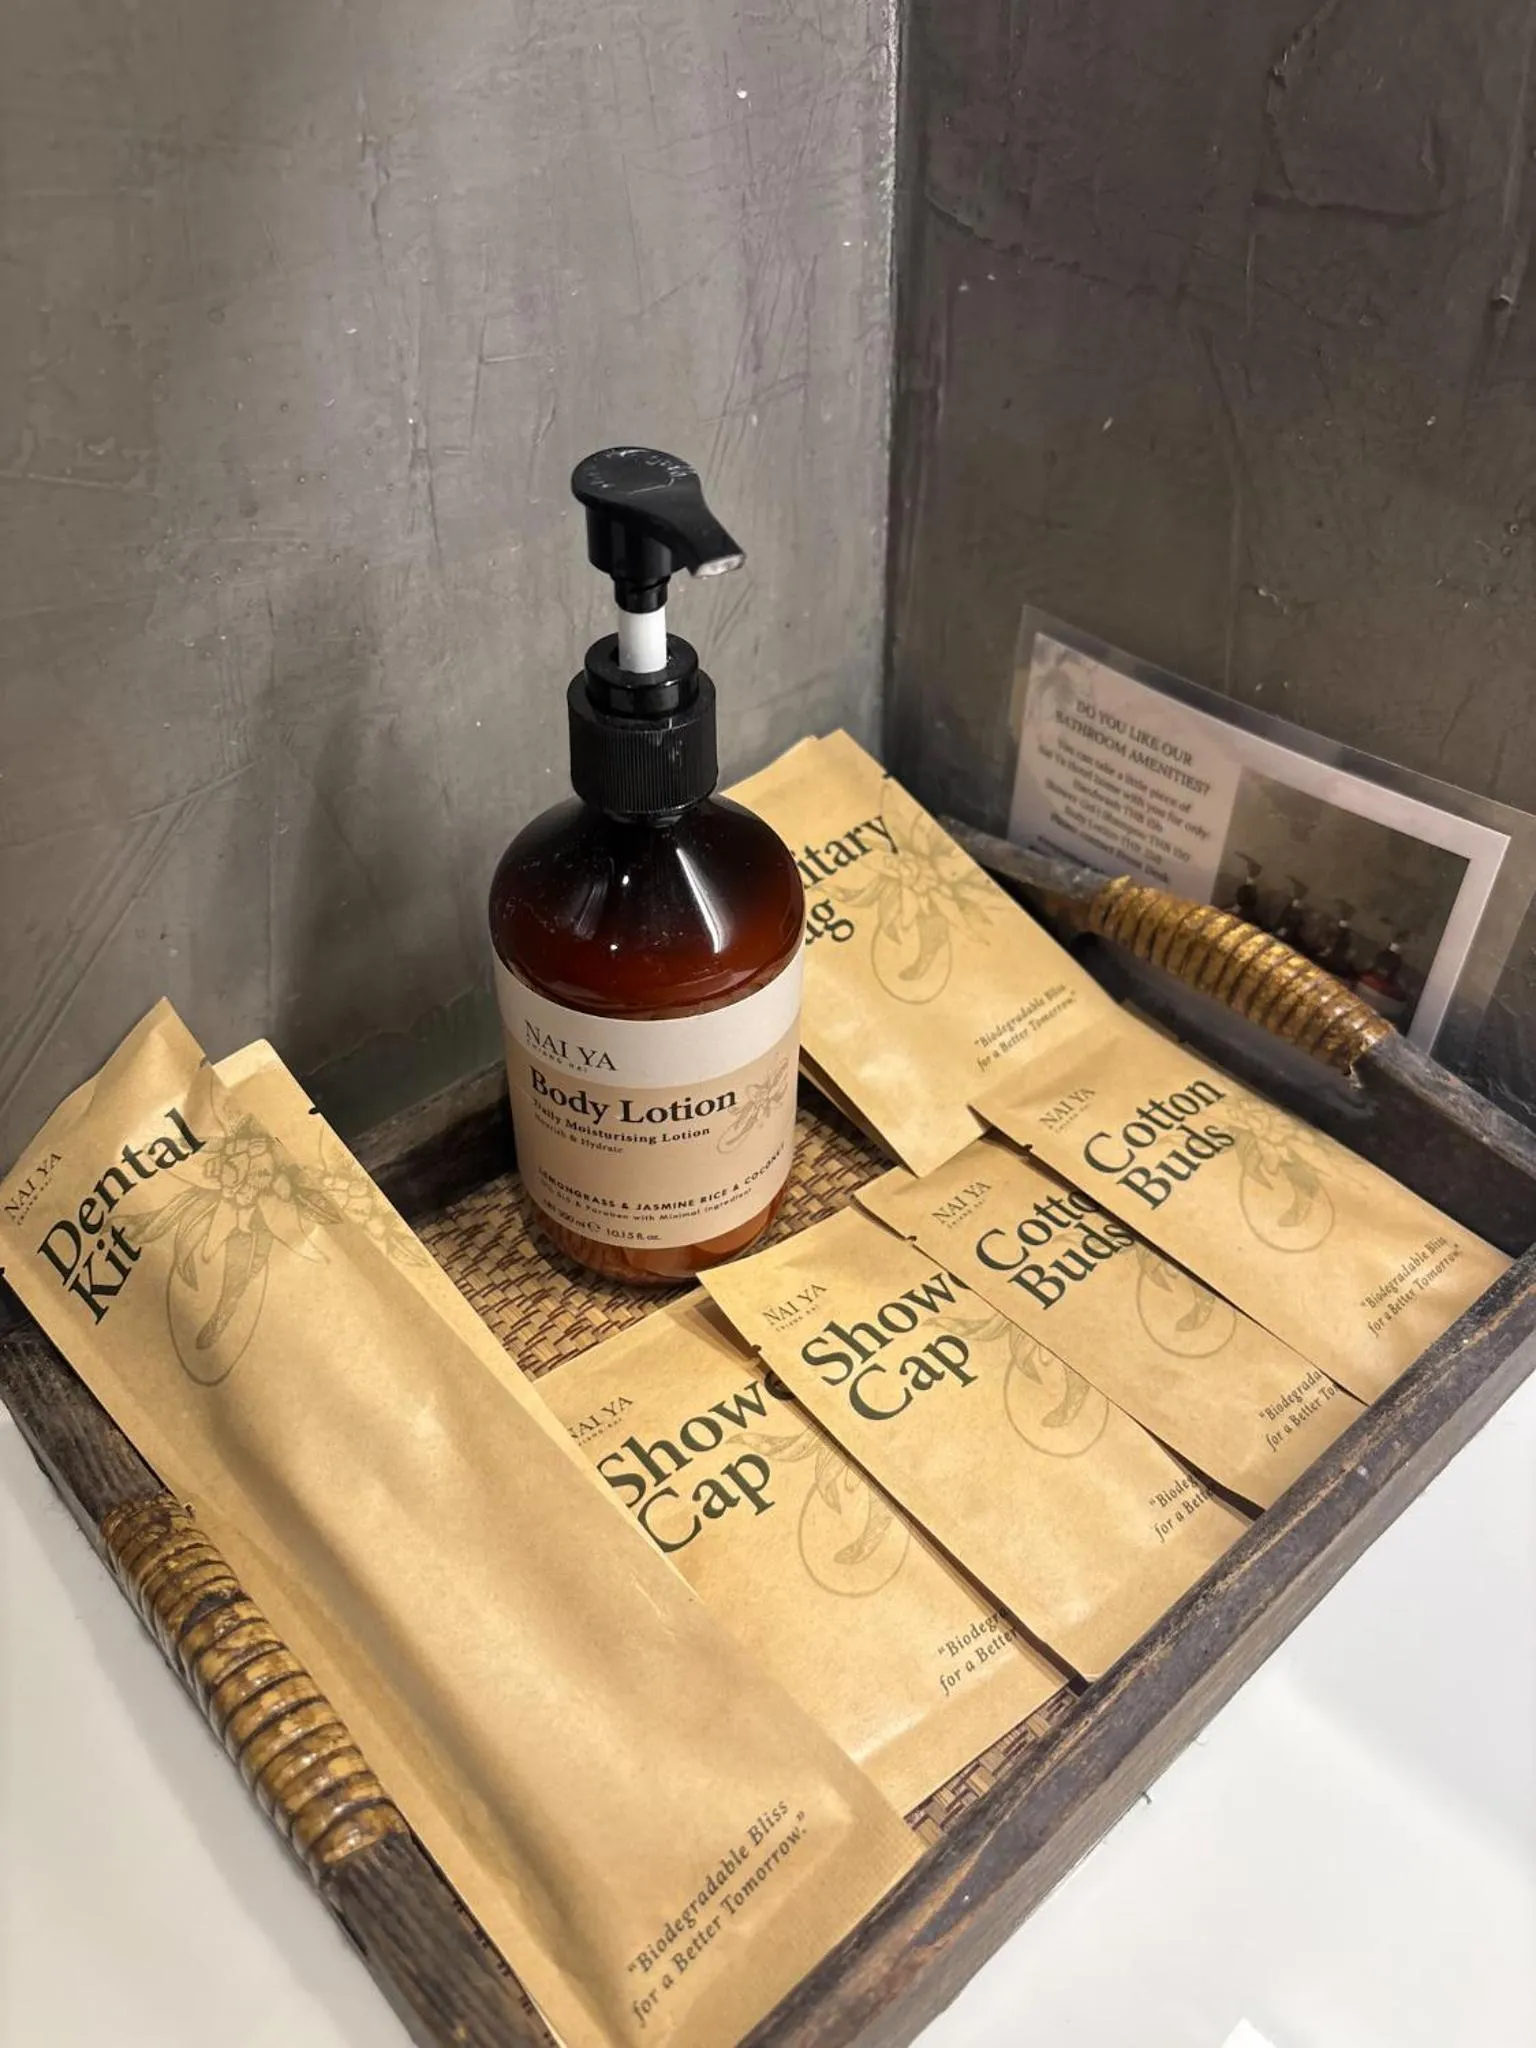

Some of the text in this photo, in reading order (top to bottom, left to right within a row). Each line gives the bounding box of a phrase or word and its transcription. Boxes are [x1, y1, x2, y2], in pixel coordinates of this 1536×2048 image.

[1055, 710, 1212, 796] BATHROOM AMENITIES?
[1099, 710, 1129, 736] YOU
[1129, 725, 1159, 752] LIKE
[1162, 741, 1194, 768] OUR
[525, 1019, 618, 1071] NAI YA
[977, 1055, 992, 1073] for
[992, 1049, 1000, 1059] a
[529, 1064, 737, 1126] Body Lotion
[1040, 1100, 1073, 1130] NAI
[1069, 1086, 1096, 1106] YA
[564, 1118, 658, 1145] Moisturising
[661, 1127, 711, 1143] Lotion
[1083, 1079, 1227, 1174] Cotton
[4, 1179, 38, 1222] NAI
[36, 1152, 63, 1178] YA
[537, 1166, 616, 1208] LEMONGRASS
[621, 1200, 630, 1210] &
[635, 1198, 695, 1212] JASMINE
[700, 1188, 728, 1205] RICE
[1116, 1124, 1236, 1211] Buds
[37, 1107, 207, 1287] Dental
[633, 1210, 656, 1221] with
[658, 1207, 701, 1222] Minimal
[932, 1195, 968, 1226] NAI
[963, 1180, 993, 1199] YA
[68, 1224, 143, 1326] Kit
[1007, 1221, 1136, 1311] Buds
[762, 1300, 800, 1328] NAI
[796, 1283, 828, 1304] YA
[801, 1271, 970, 1386] Show
[1367, 1317, 1386, 1339] for
[1384, 1310, 1393, 1321] a
[1387, 1288, 1417, 1316] Better
[849, 1334, 979, 1421] Cap
[1259, 1370, 1323, 1421] "Biodegrada
[601, 1396, 634, 1418] YA
[1264, 1396, 1323, 1453] for a Better
[597, 1371, 797, 1509] Showe
[637, 1453, 776, 1554] Cap
[1153, 1516, 1175, 1544] for
[1175, 1510, 1185, 1523] a
[940, 1625, 1018, 1697] for a Better
[627, 1800, 790, 1974] "Biodegradable Bliss
[632, 1809, 808, 2030] for a Better Tomorrow."
